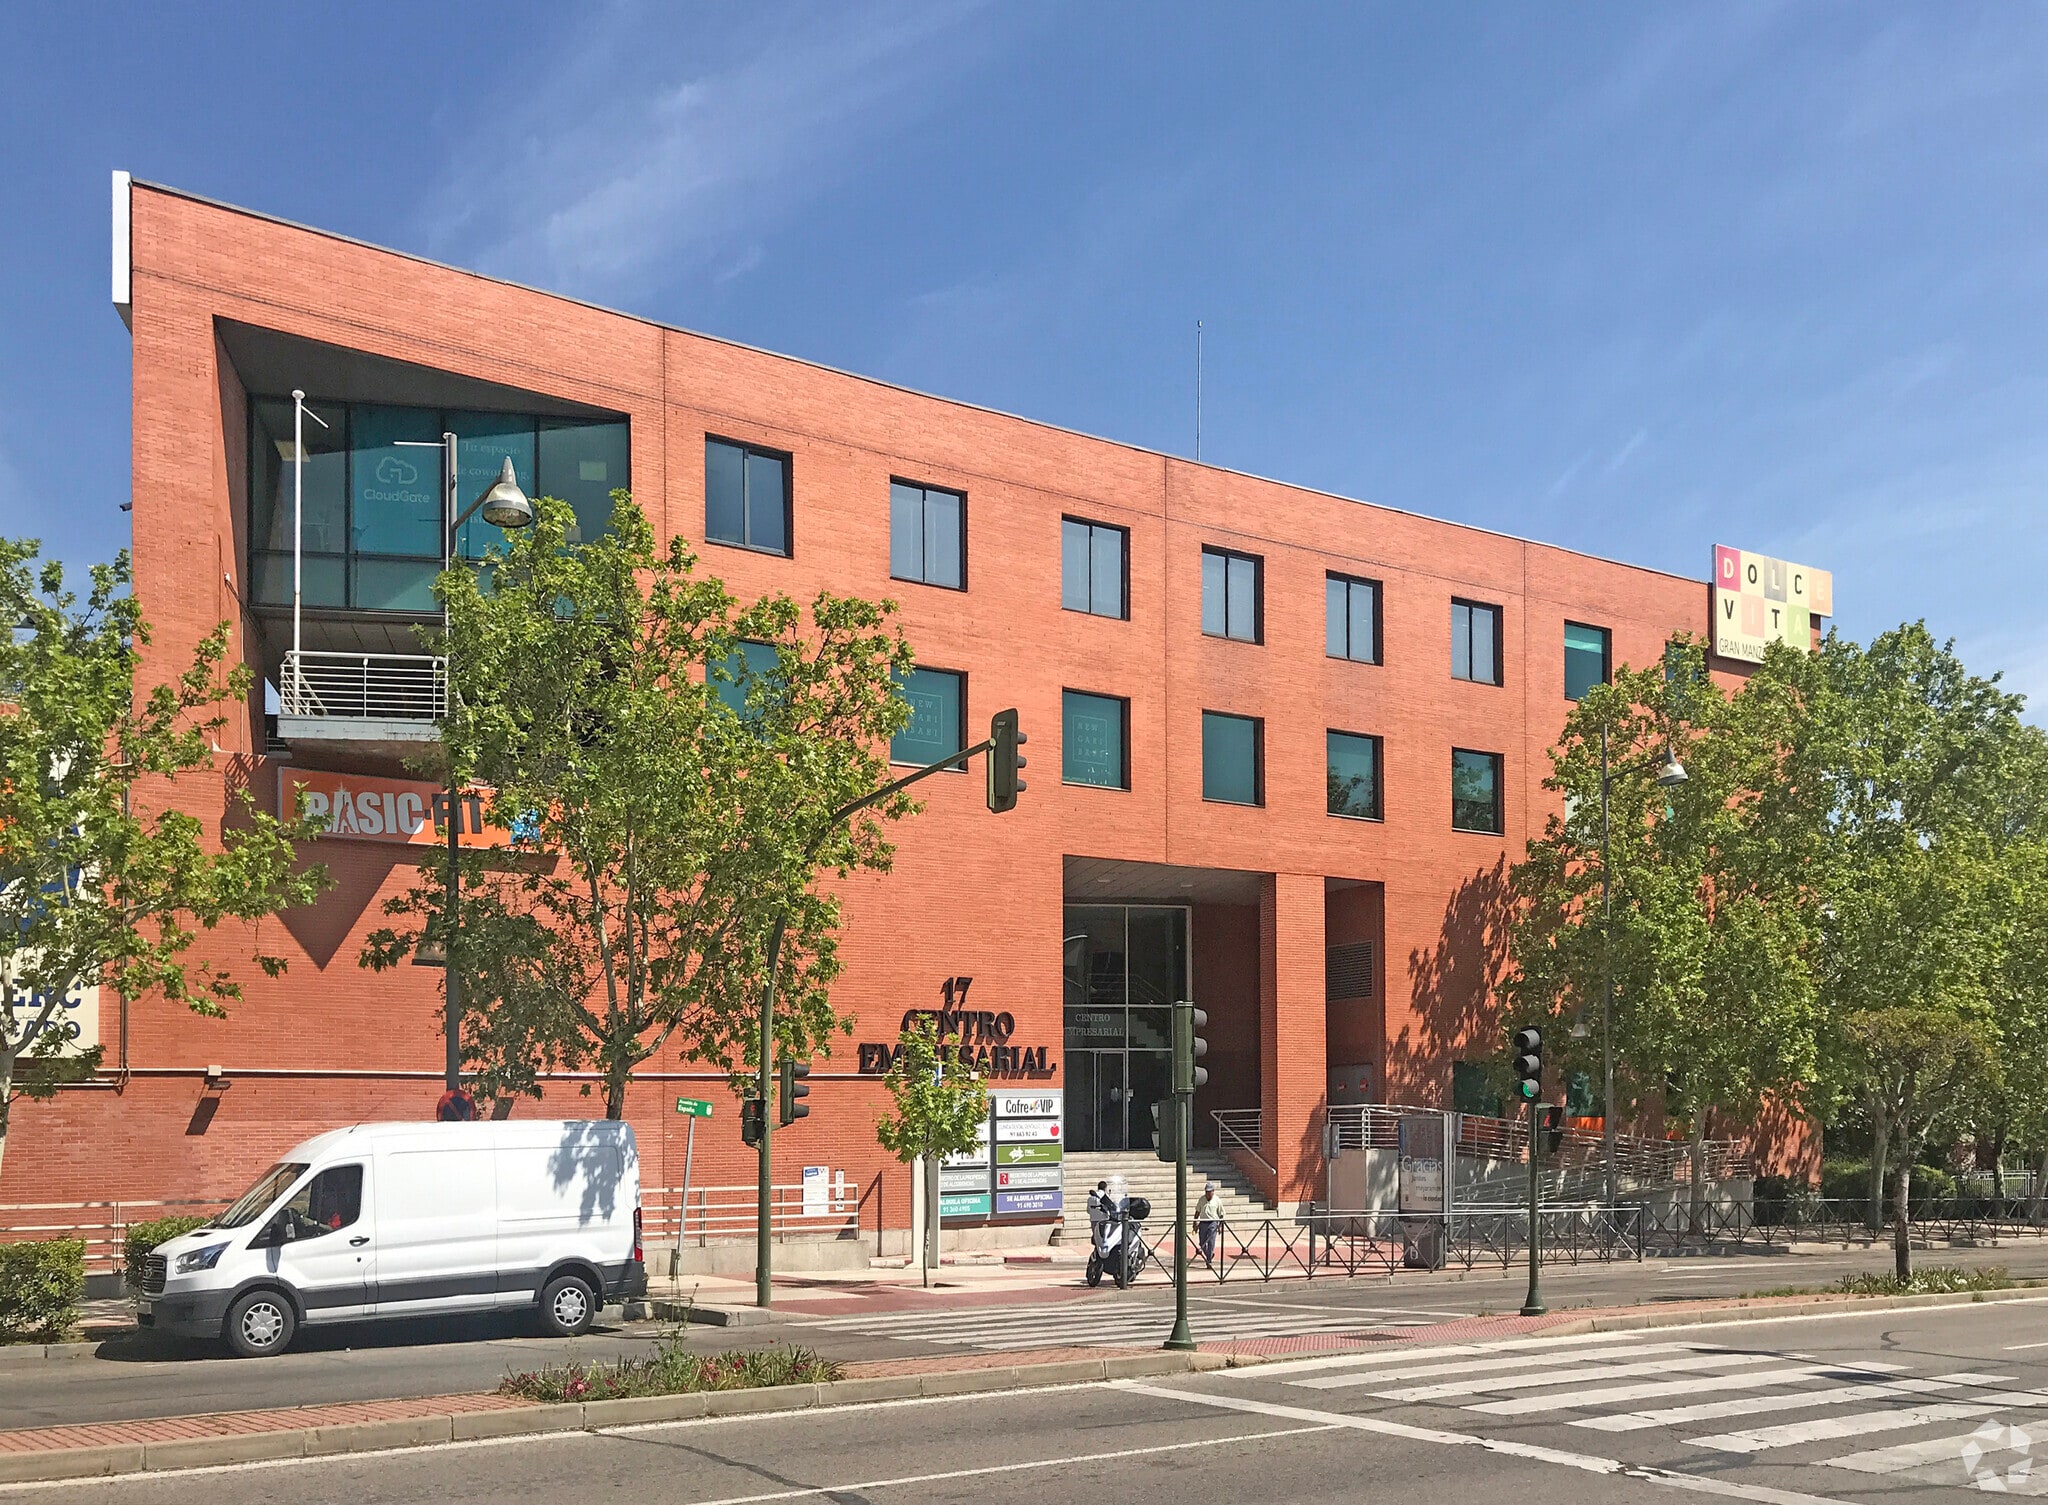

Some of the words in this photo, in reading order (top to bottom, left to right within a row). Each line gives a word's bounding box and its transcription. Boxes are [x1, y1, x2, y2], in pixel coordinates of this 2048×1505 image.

[363, 489, 431, 504] CloudGate
[1723, 557, 1825, 601] DOLCE
[1724, 598, 1804, 636] VITA
[1718, 637, 1741, 655] GRAN
[939, 976, 974, 1007] 17
[1075, 1013, 1111, 1022] CENTRO
[1005, 1099, 1029, 1114] Cofre
[1040, 1099, 1054, 1113] VIP
[1401, 1155, 1443, 1173] Gracias
